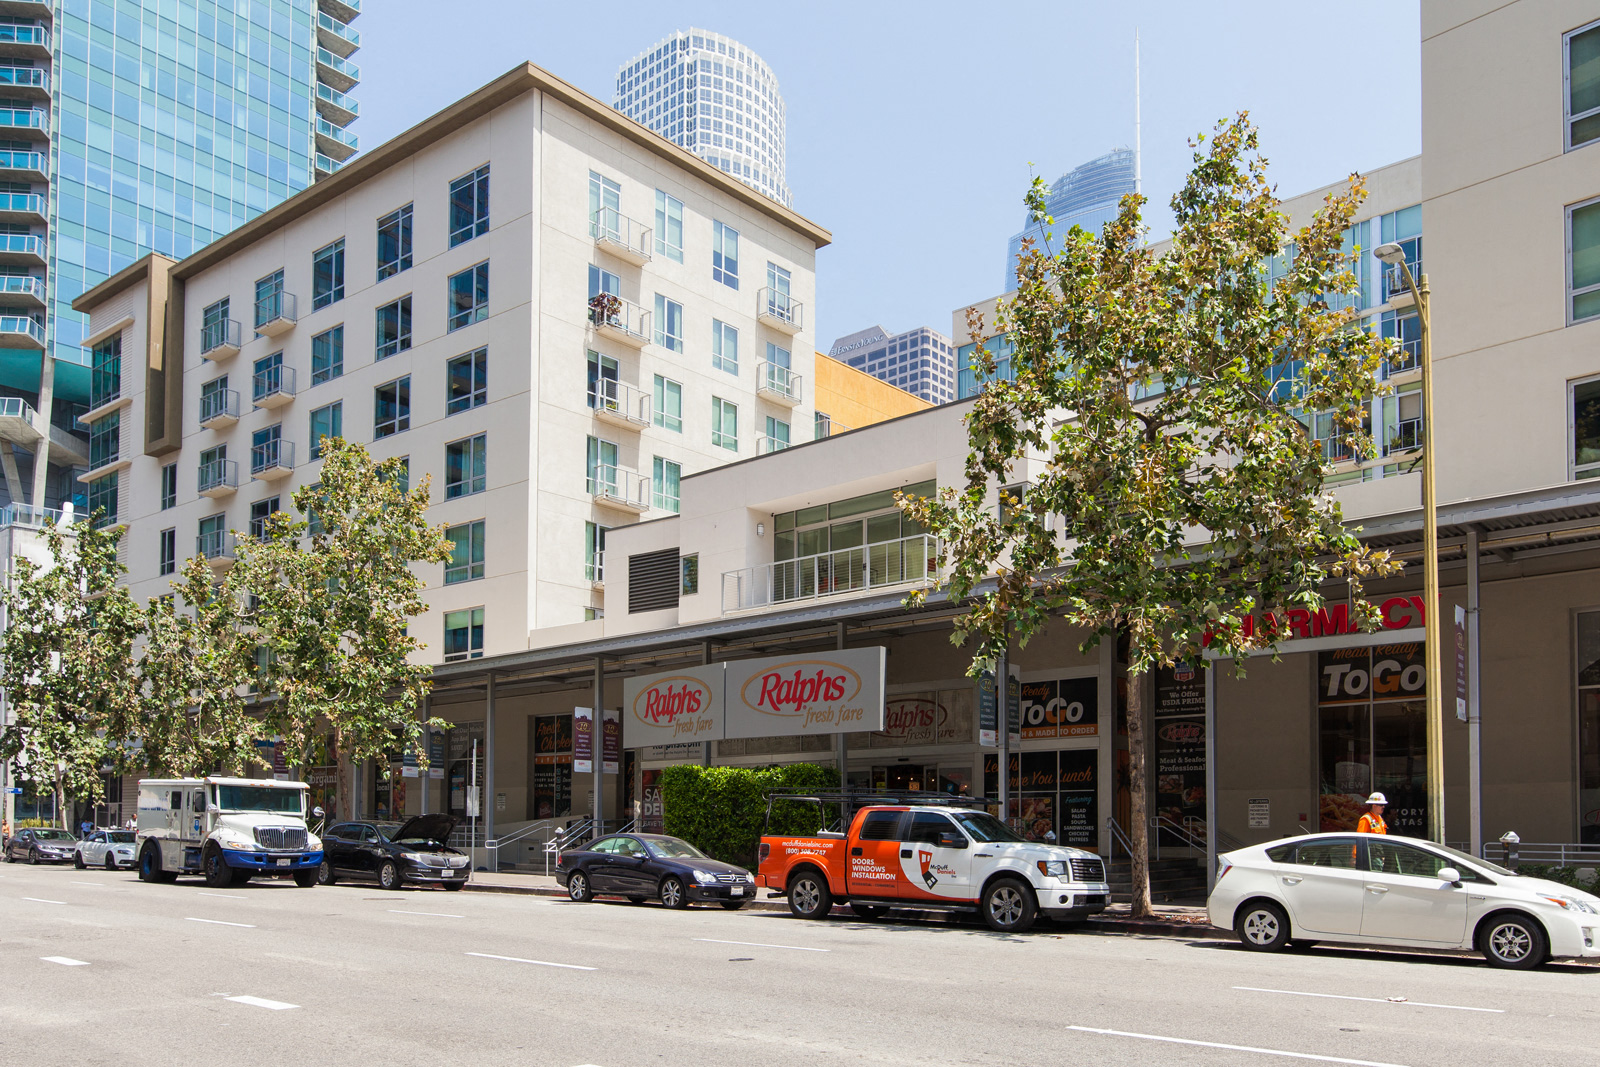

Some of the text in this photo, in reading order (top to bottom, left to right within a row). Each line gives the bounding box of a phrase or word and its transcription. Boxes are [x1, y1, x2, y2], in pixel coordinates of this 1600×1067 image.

[1202, 593, 1441, 648] RMCY
[1376, 643, 1419, 661] Ready
[1323, 659, 1426, 696] ToGo
[757, 669, 846, 711] Ralphs
[1022, 683, 1050, 701] Ready
[1181, 690, 1199, 698] Offer
[643, 684, 702, 723] Ralphs
[1020, 697, 1084, 725] ToGo
[803, 704, 864, 728] fresh fare
[885, 704, 934, 734] Ralphs
[672, 715, 714, 738] fresh fare
[1028, 730, 1035, 738] &
[1035, 729, 1056, 737] MADE
[1059, 728, 1069, 736] TO
[1070, 727, 1095, 735] ORDER
[903, 729, 931, 743] fresh
[985, 759, 999, 774] Le
[310, 772, 337, 786] organi
[1009, 766, 1093, 788] rve You Lunch
[1340, 781, 1364, 789] NEW
[376, 783, 390, 792] local
[1396, 808, 1425, 816] ORY
[782, 839, 834, 848] mcduffdanielsinc.com
[851, 872, 896, 880] INSTALLATION
[852, 865, 886, 873] WINDOWS
